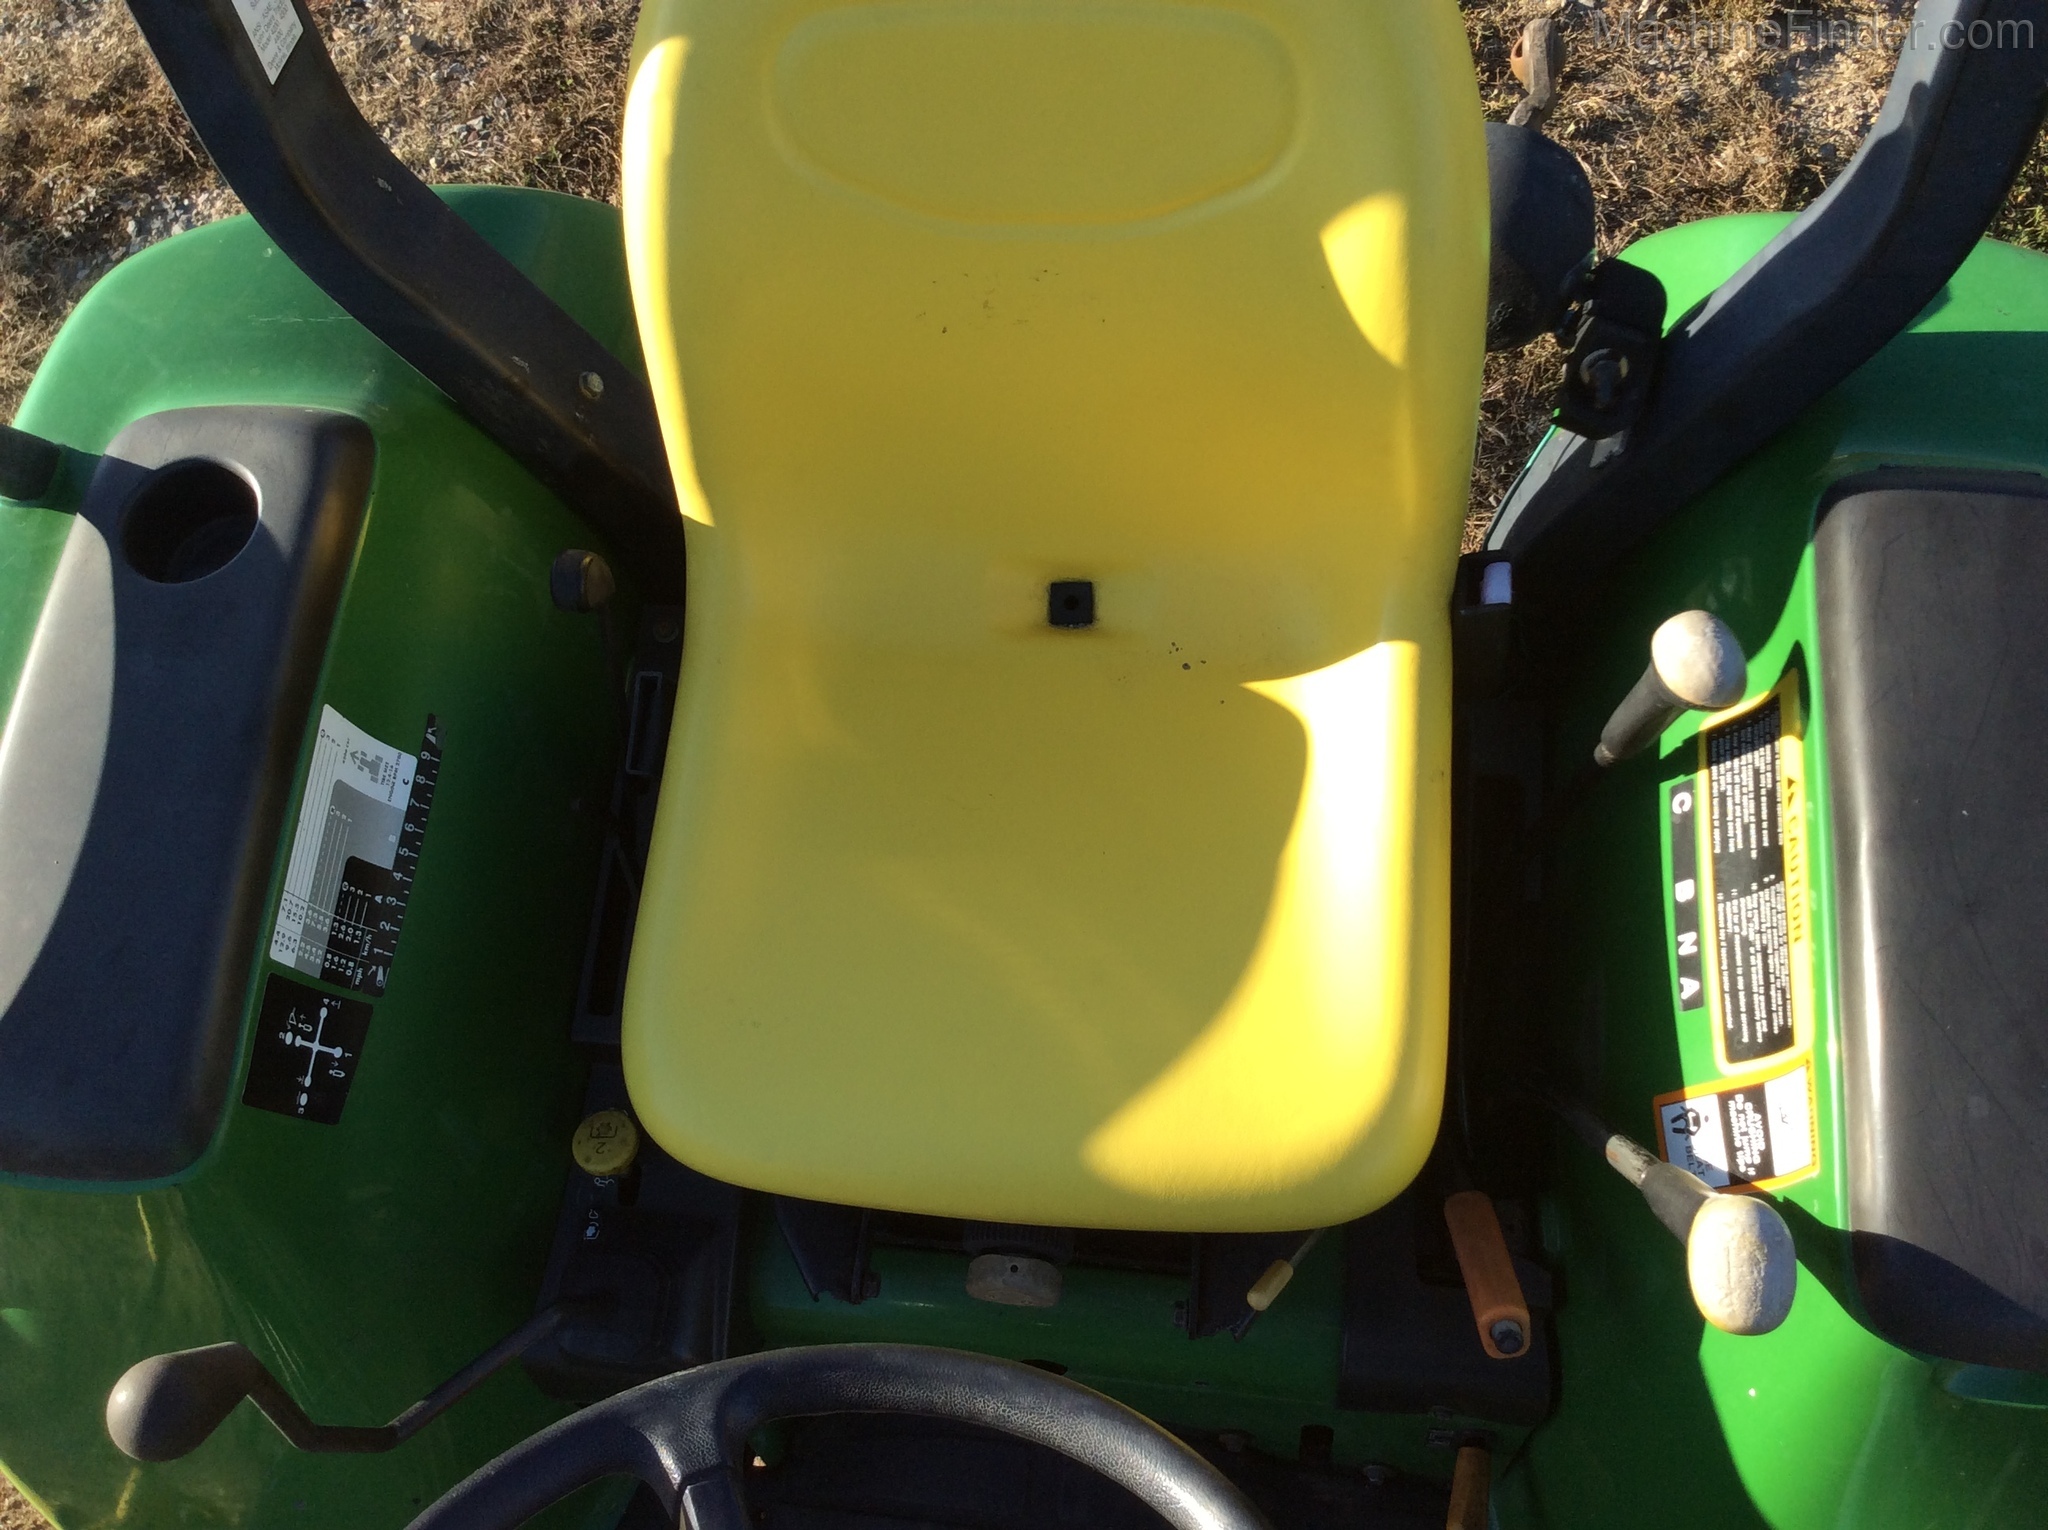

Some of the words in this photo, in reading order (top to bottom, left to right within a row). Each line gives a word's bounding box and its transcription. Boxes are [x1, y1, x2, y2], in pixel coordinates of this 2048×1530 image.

[1672, 792, 1692, 814] C
[380, 921, 390, 930] 2
[386, 896, 396, 905] 3
[393, 872, 403, 880] 4
[399, 846, 409, 857] 5
[405, 823, 415, 832] 6
[410, 798, 419, 806] 7
[416, 775, 425, 784] 8
[421, 751, 430, 760] 9
[375, 895, 382, 903] A
[1675, 879, 1695, 902] B
[1677, 931, 1697, 955] N
[338, 959, 346, 971] 1.2
[346, 961, 354, 976] 0.8
[355, 968, 363, 985] mph
[362, 935, 372, 956] km/h
[1680, 977, 1700, 999] A
